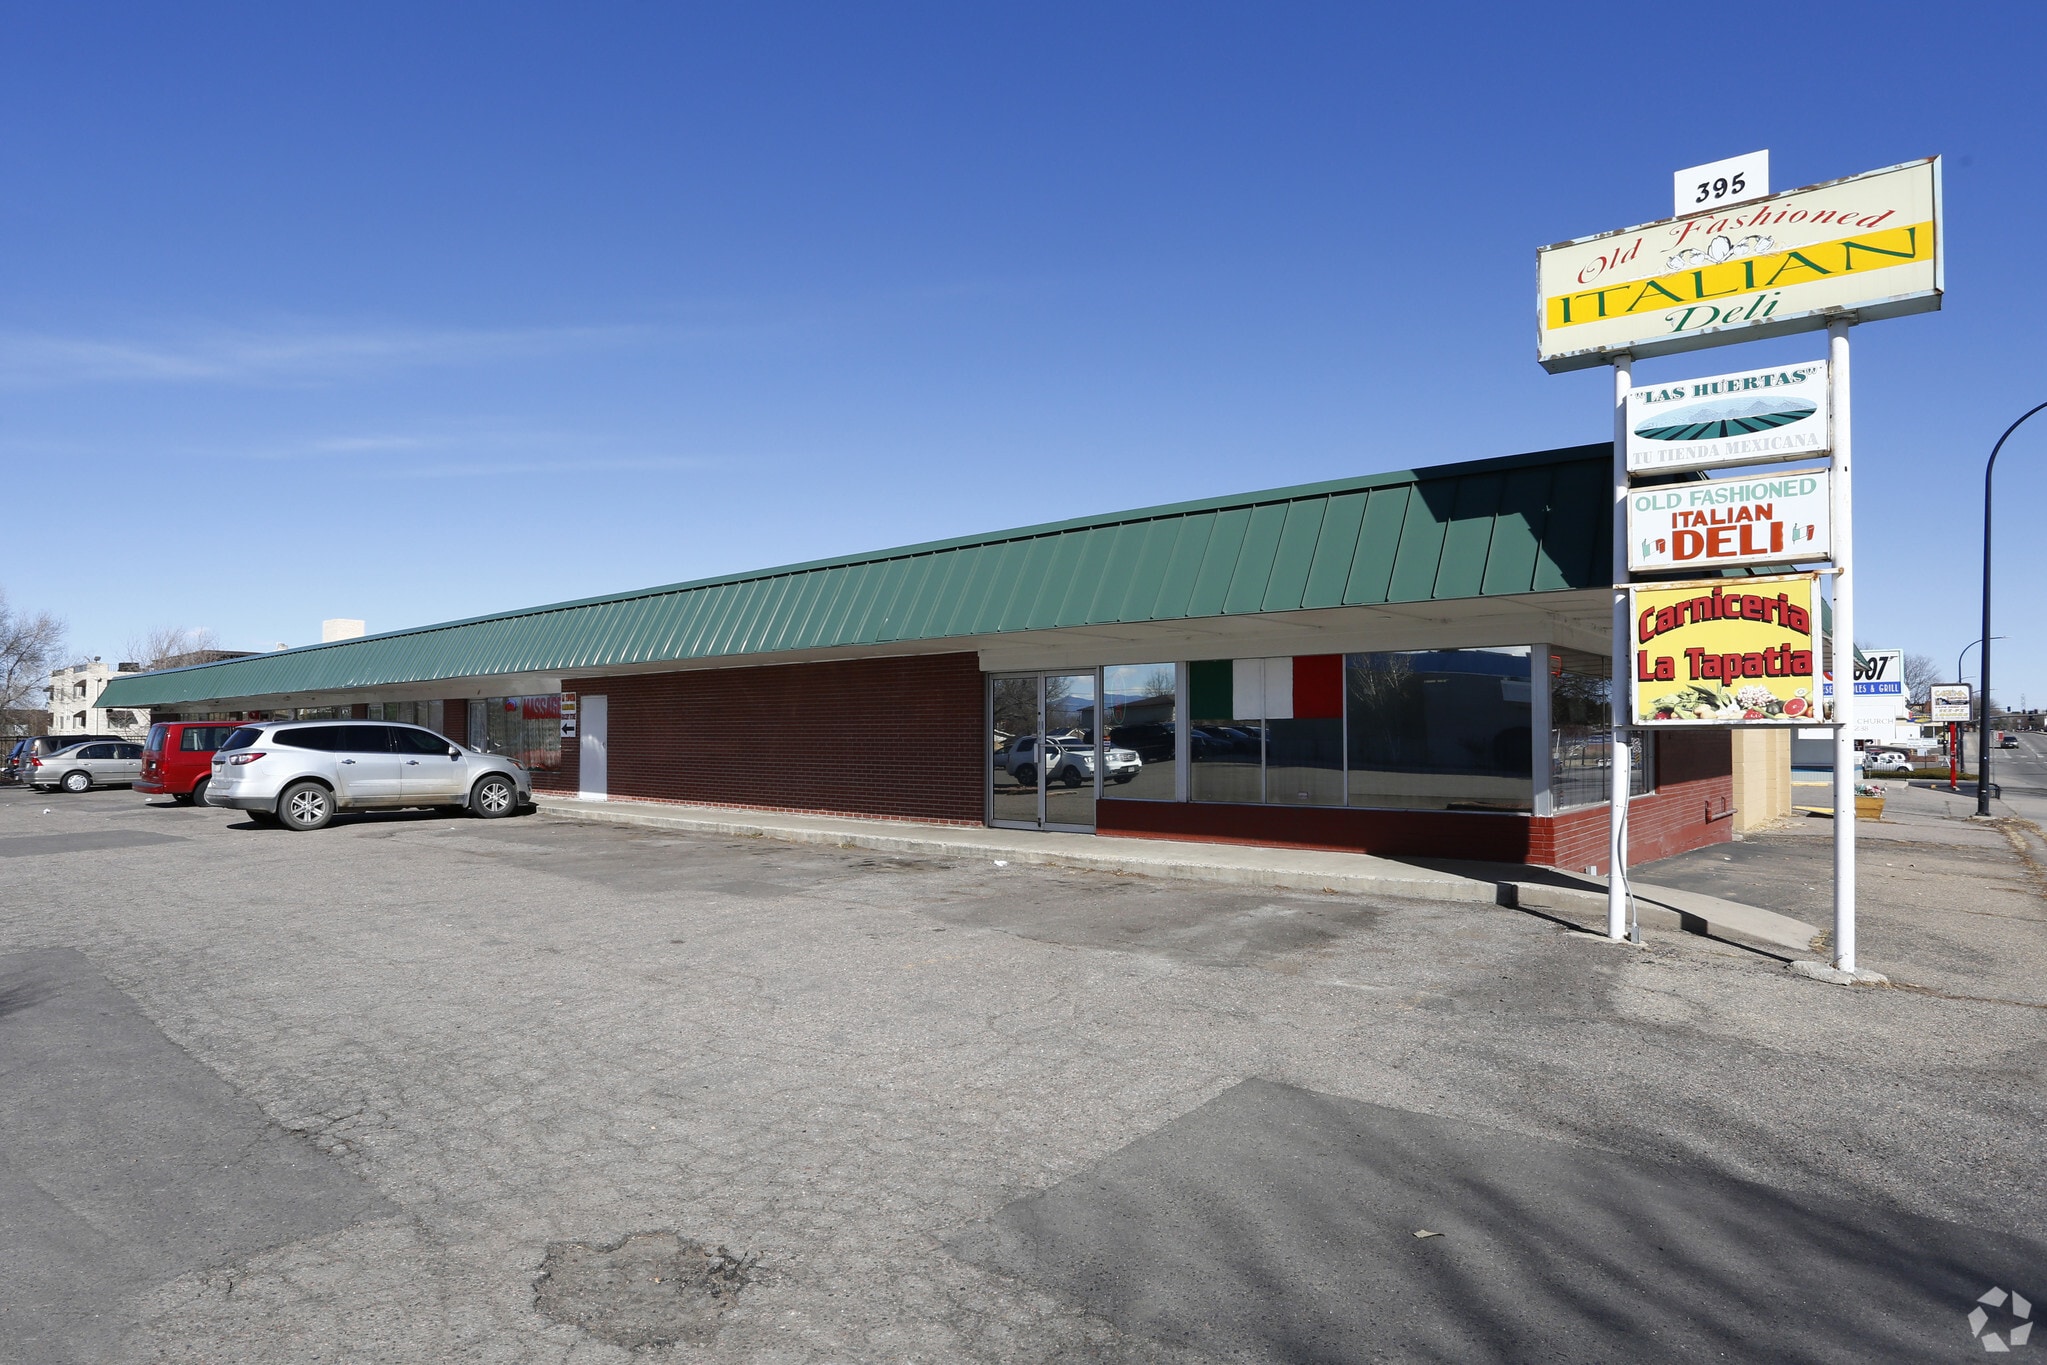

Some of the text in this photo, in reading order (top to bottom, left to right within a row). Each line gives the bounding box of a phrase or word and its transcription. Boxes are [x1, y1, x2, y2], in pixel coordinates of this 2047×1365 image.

[1695, 171, 1746, 204] 395
[1577, 203, 1896, 284] Old Fashioned
[1562, 227, 1917, 323] ITALIAN
[1665, 291, 1781, 332] Deli
[1633, 432, 1819, 465] TU TIENDA MEXICANA
[1635, 478, 1817, 512] OLD FASHIONED
[1672, 503, 1773, 529] ITALIAN
[1672, 521, 1784, 561] DELI
[1638, 586, 1811, 645] Carniceria
[1637, 643, 1813, 687] La Tapatia
[1870, 684, 1875, 693] &
[1879, 683, 1899, 693] GRILL
